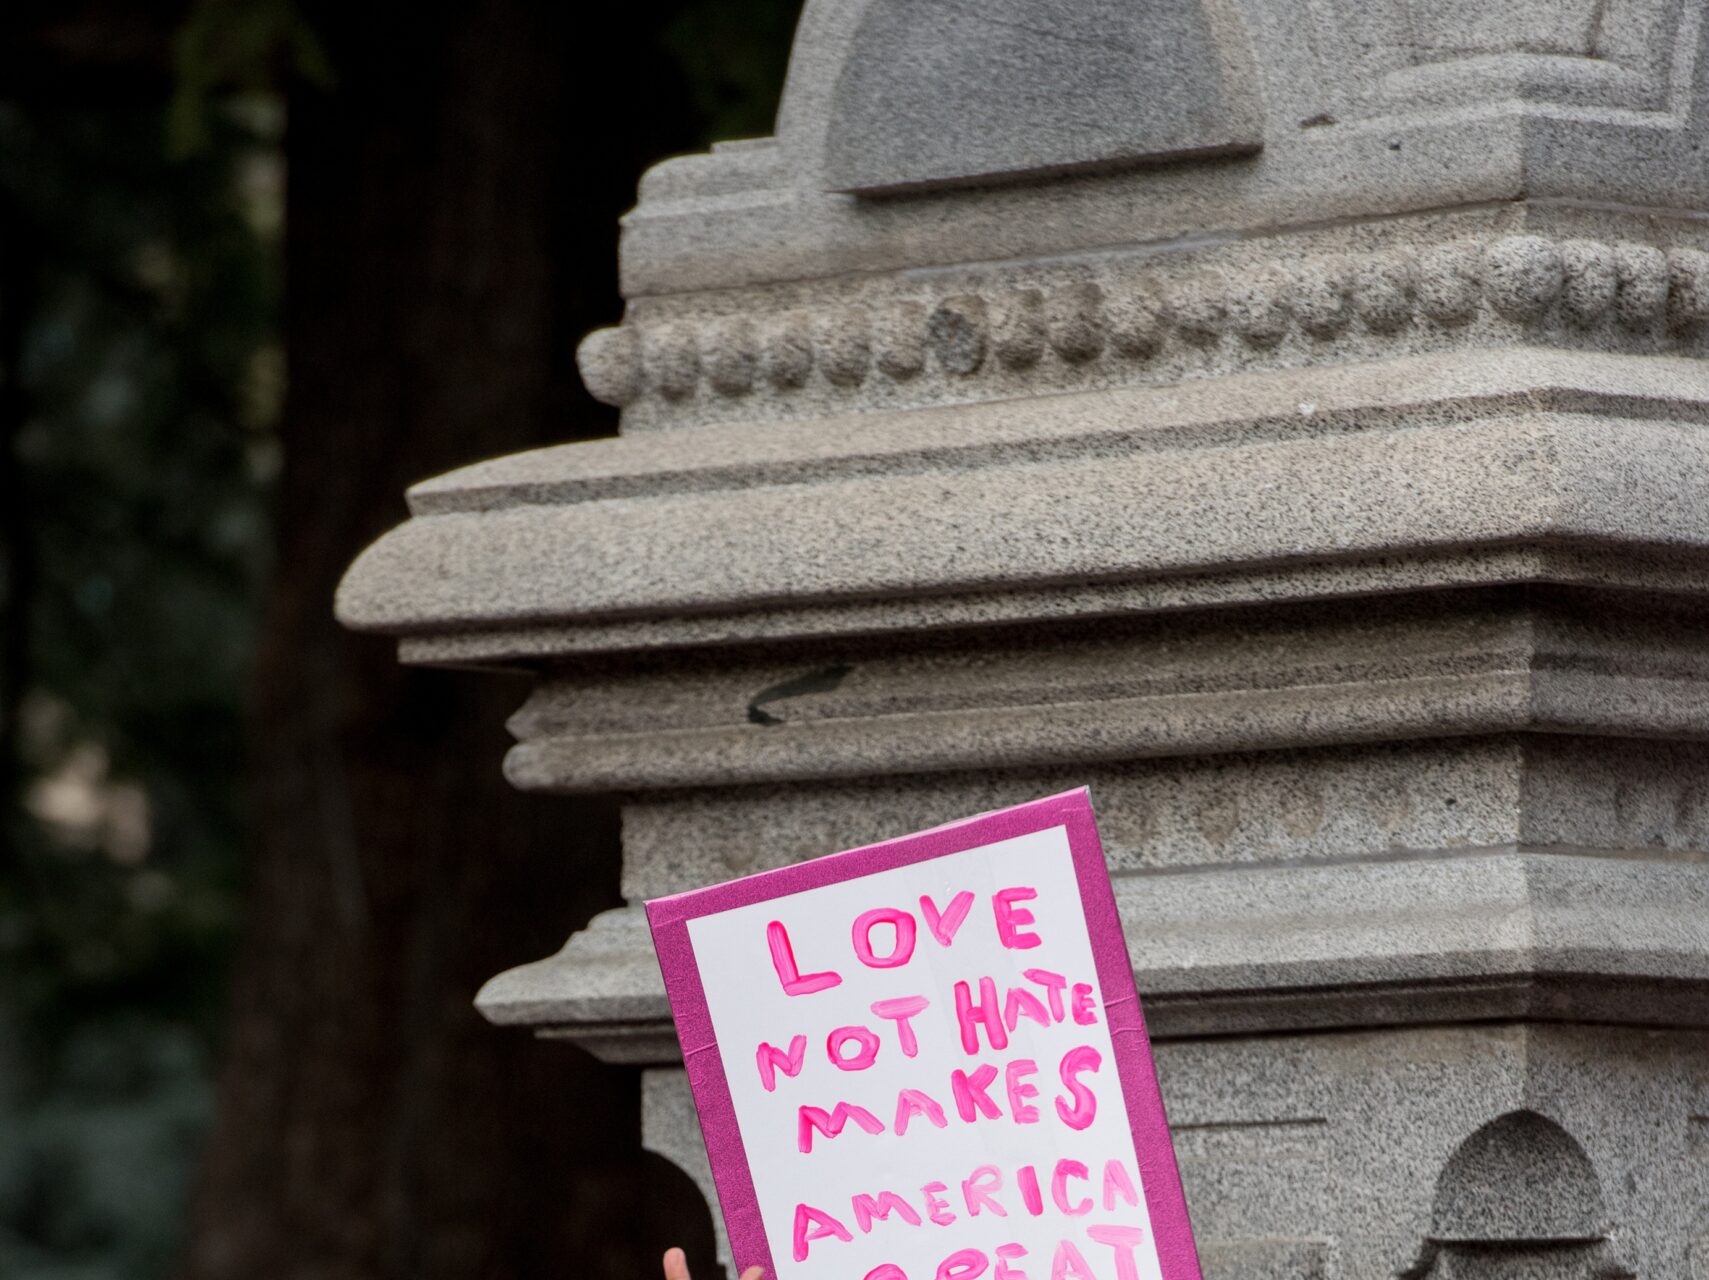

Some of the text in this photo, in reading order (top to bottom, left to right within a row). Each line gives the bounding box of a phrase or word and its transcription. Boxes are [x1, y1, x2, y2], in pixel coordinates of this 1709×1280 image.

[767, 887, 1041, 996] LOVE
[756, 968, 1098, 1093] NOT HATE
[798, 1045, 1103, 1153] MAKES
[793, 1158, 1139, 1263] AMERICA
